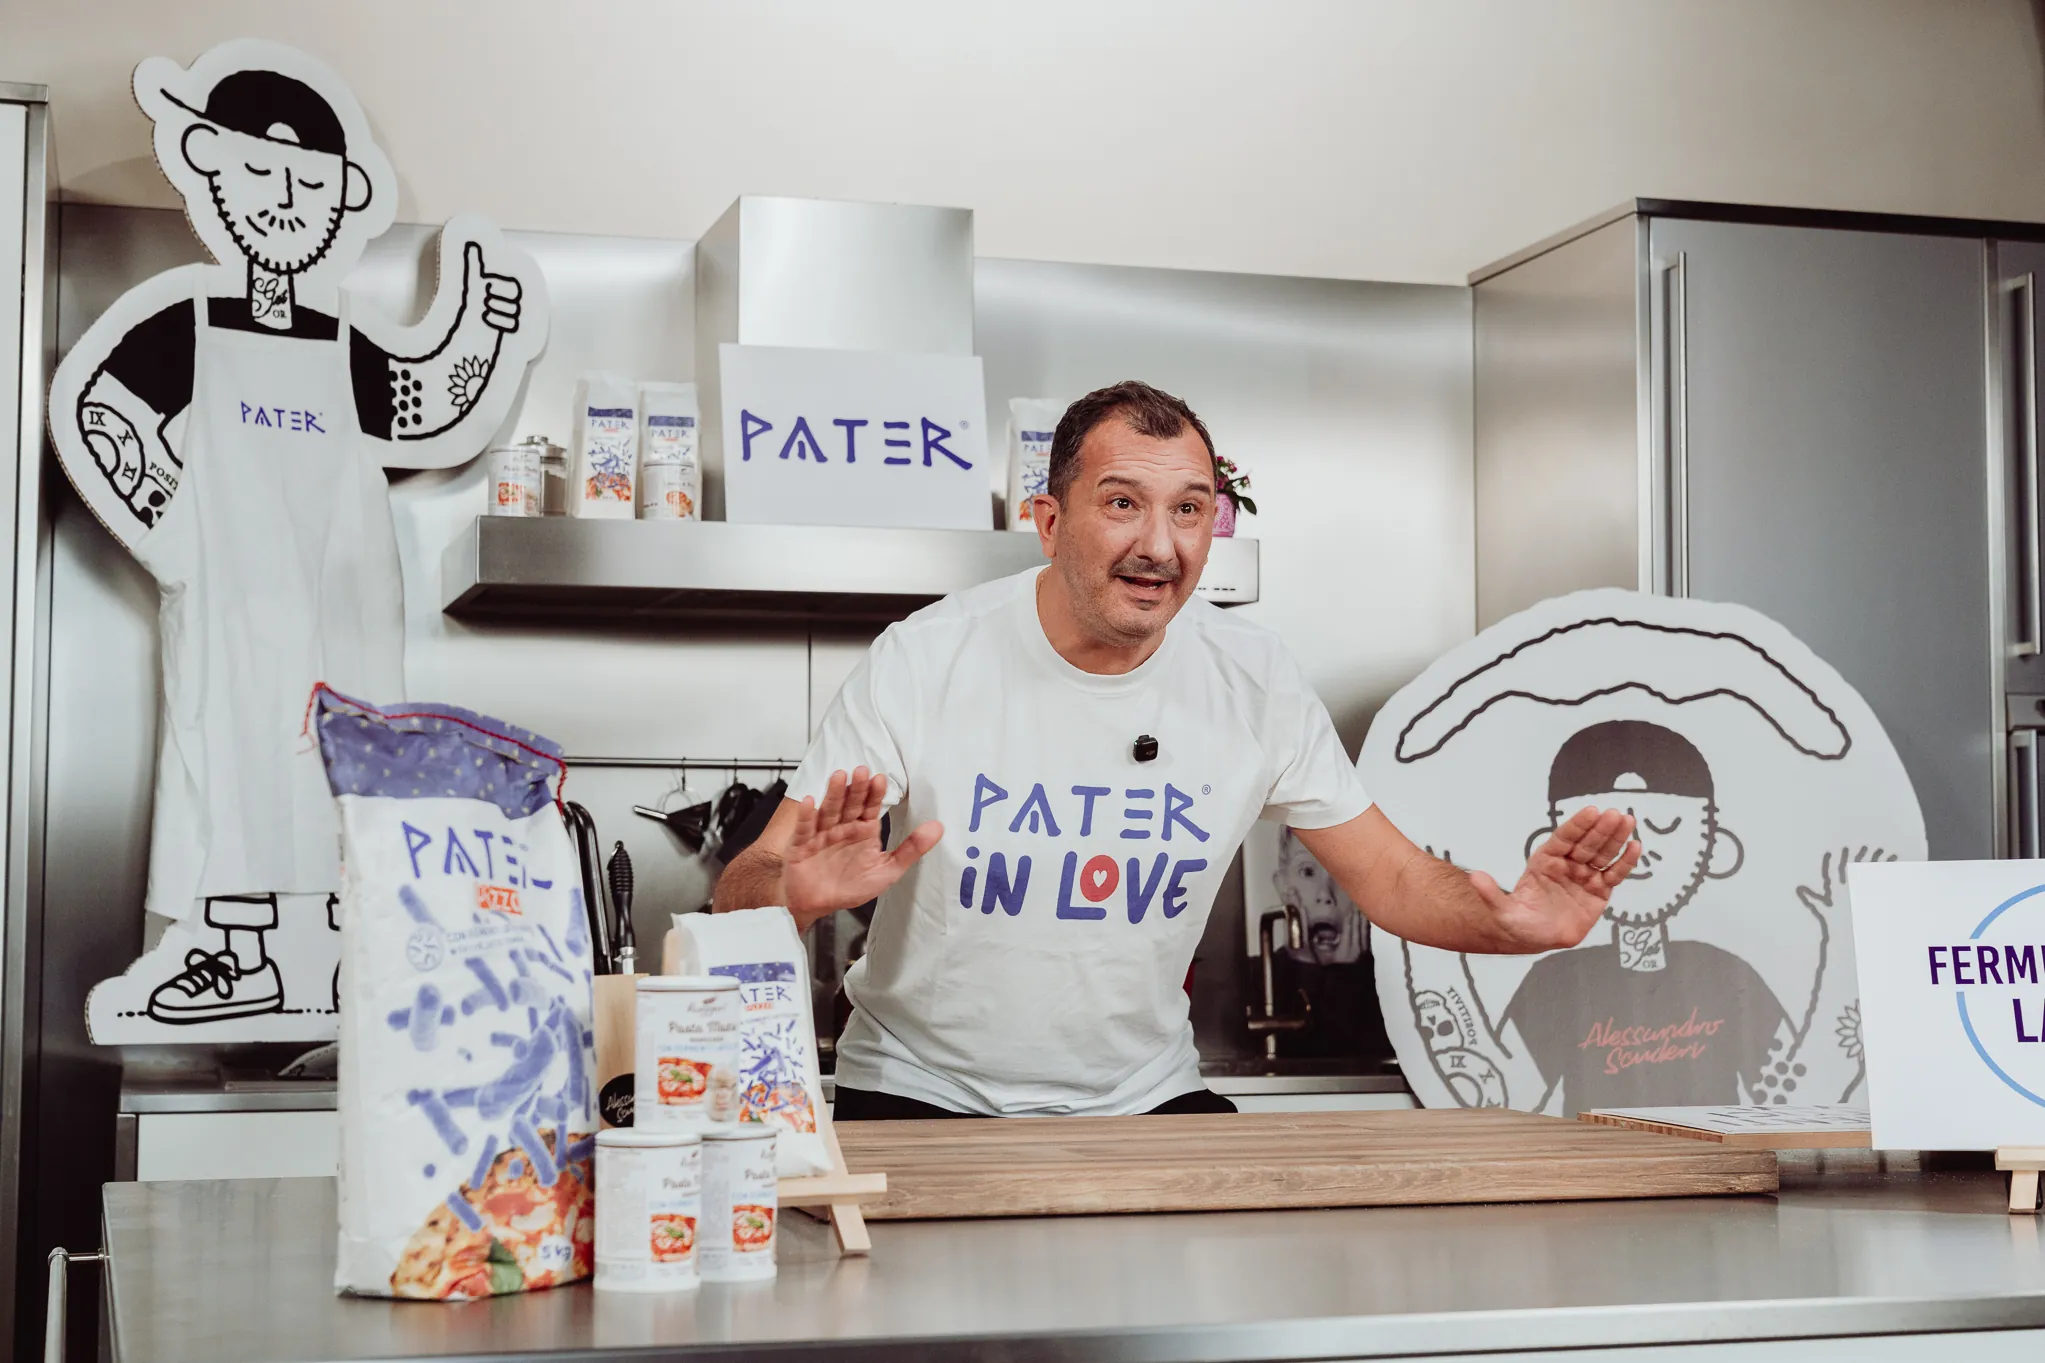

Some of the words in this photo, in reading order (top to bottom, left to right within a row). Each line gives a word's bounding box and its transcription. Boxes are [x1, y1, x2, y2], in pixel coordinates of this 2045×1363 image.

[272, 310, 287, 319] OR
[89, 410, 106, 427] IX
[240, 400, 326, 434] PATER
[116, 429, 134, 448] X
[741, 409, 973, 470] PATER
[968, 773, 1210, 842] PATER
[1056, 851, 1208, 925] LOVE
[1928, 944, 2045, 985] FERM
[740, 986, 792, 1003] TER
[1577, 1006, 1725, 1049] Alessandro
[2012, 998, 2045, 1043] L
[541, 1245, 551, 1259] 5
